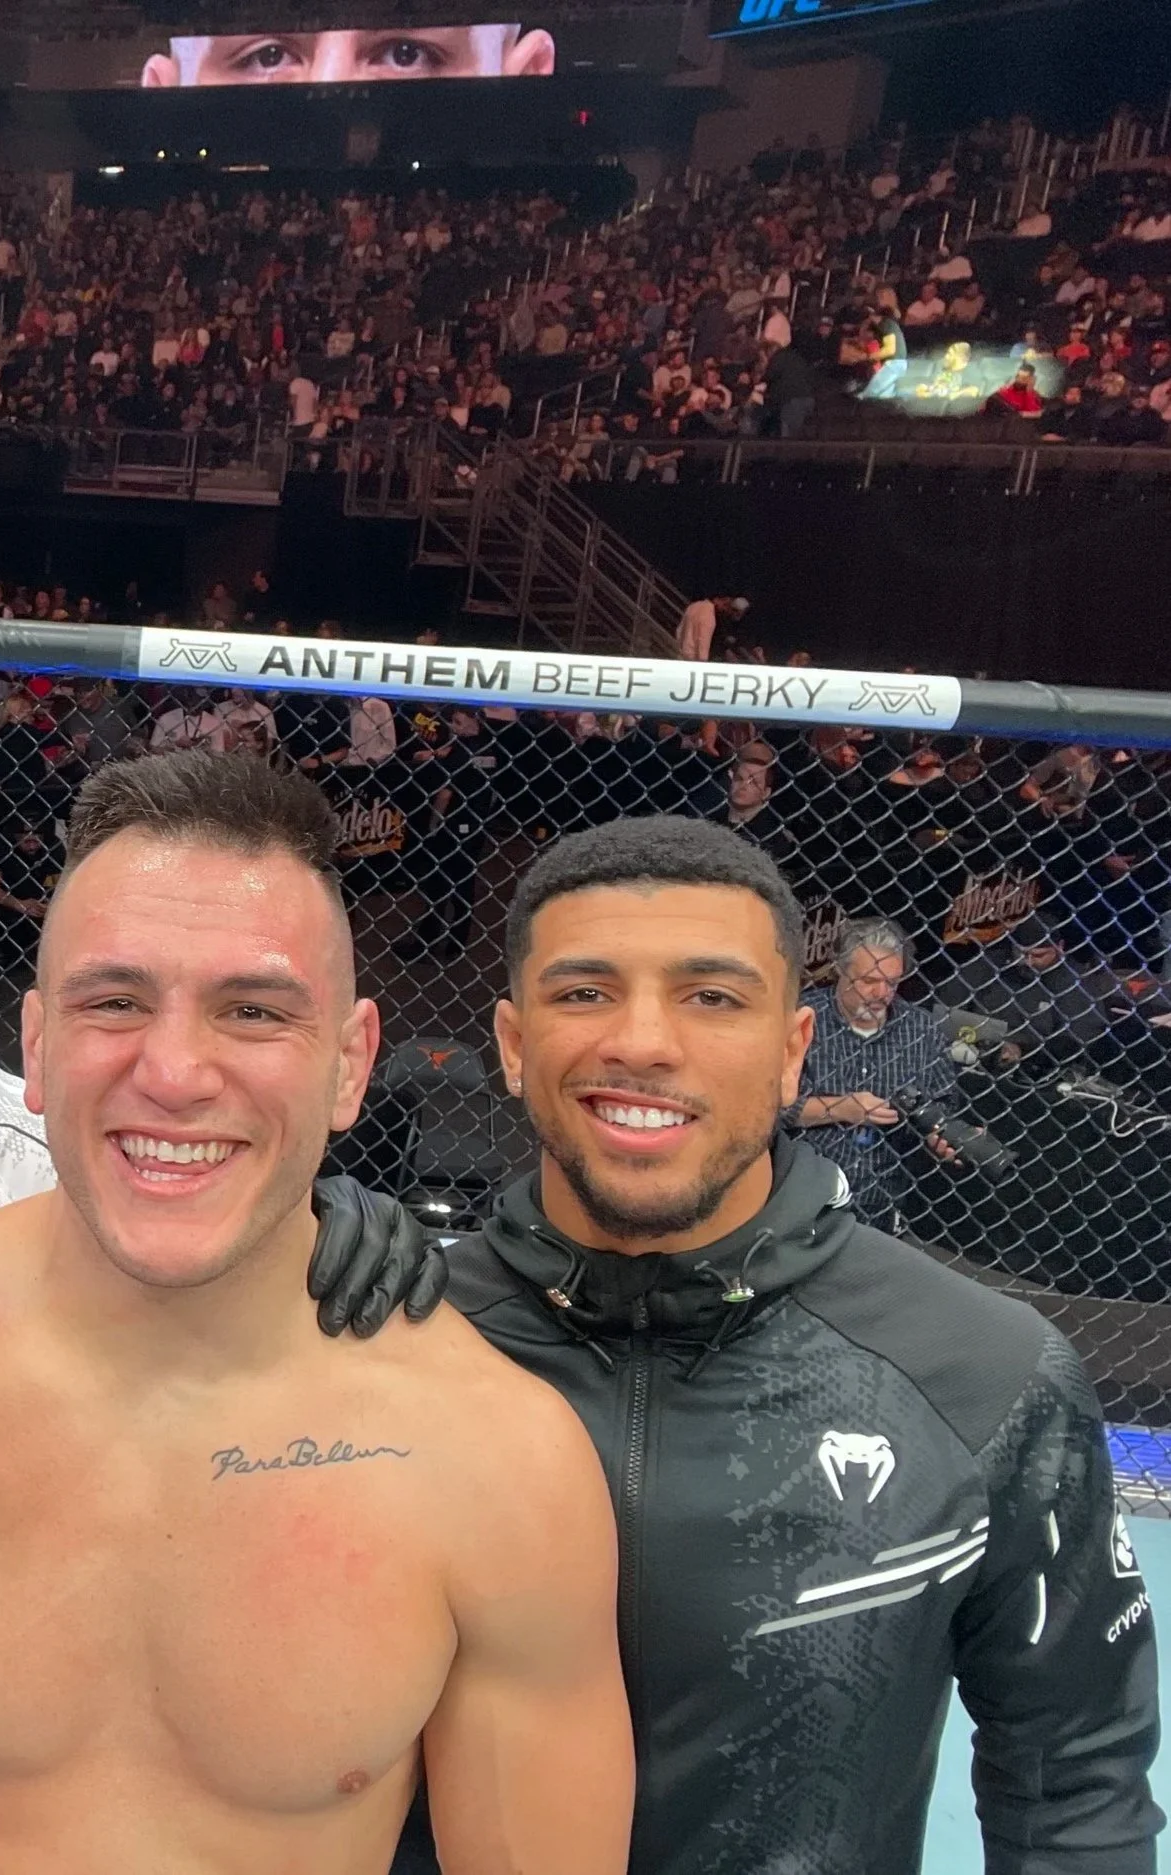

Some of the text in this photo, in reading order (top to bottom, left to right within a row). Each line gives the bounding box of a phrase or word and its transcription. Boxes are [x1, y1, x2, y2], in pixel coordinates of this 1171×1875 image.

[258, 645, 829, 710] ANTHEM BEEF JERKY
